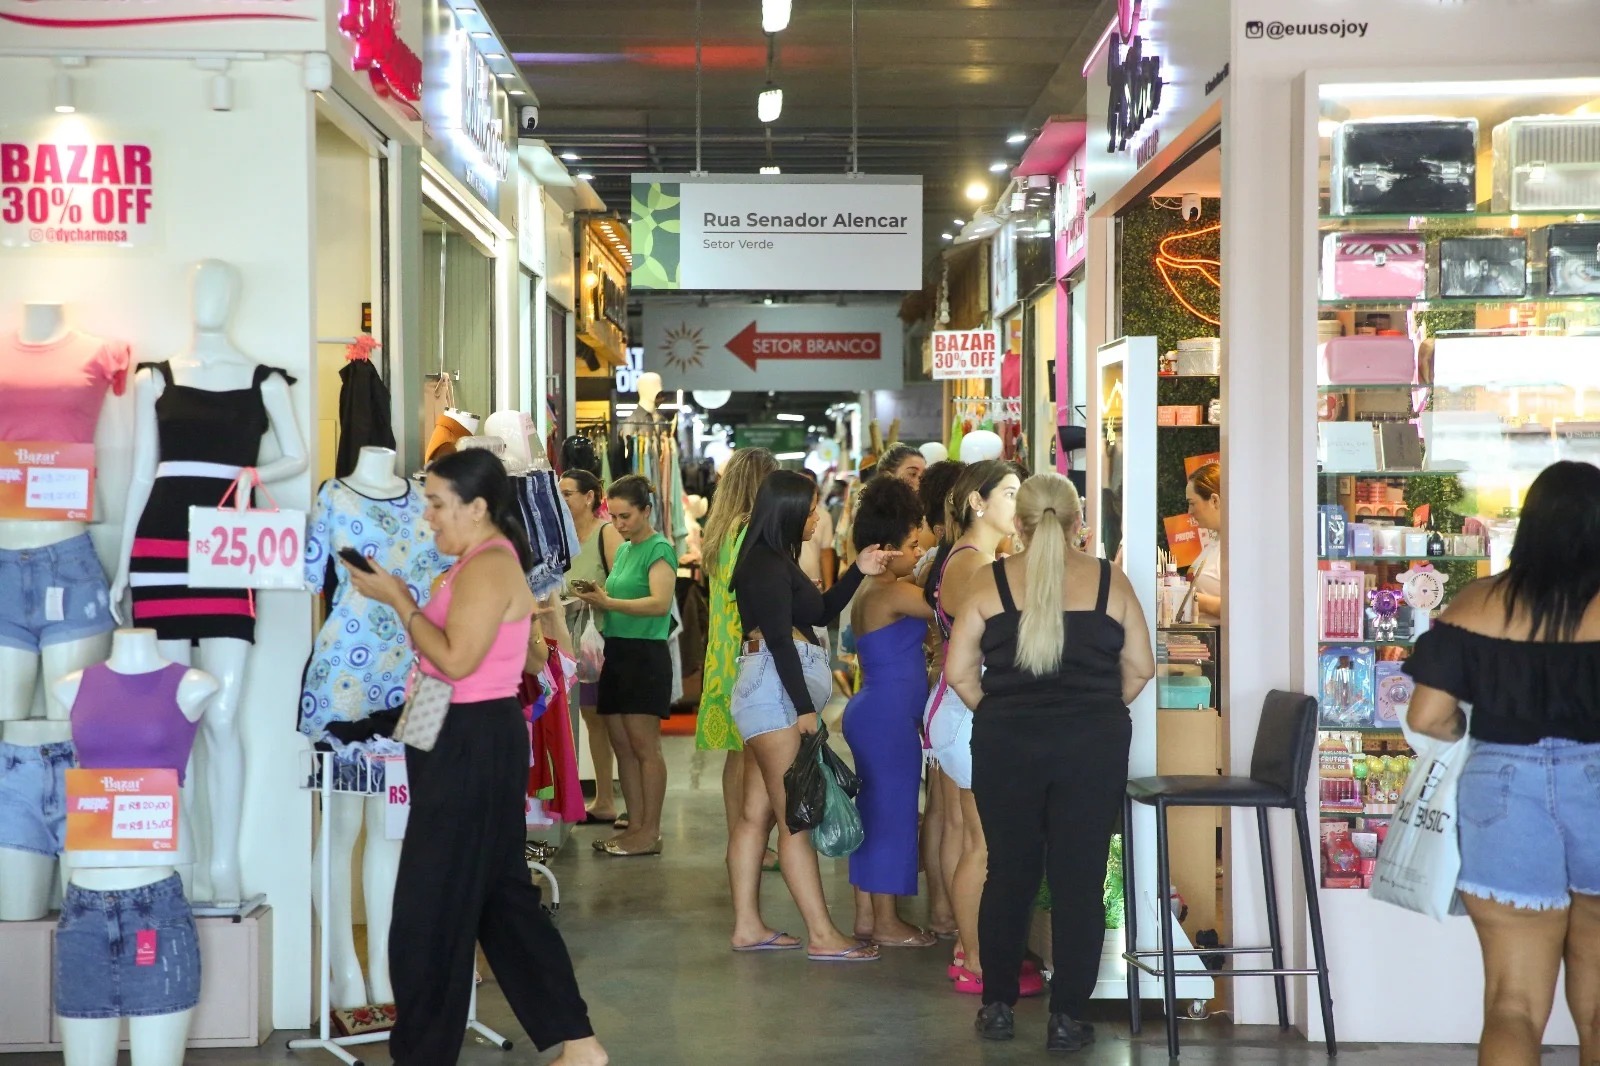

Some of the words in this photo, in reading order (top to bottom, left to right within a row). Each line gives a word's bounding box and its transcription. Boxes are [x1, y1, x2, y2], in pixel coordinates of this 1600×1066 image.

[1266, 20, 1369, 40] @euusojoy
[0, 143, 152, 185] BAZAR
[2, 187, 83, 224] 30%
[93, 187, 152, 224] OFF
[703, 212, 741, 227] Rua
[746, 212, 828, 228] Senador
[832, 213, 908, 228] Alencar
[46, 228, 128, 242] @dycharmosa
[703, 239, 735, 249] Setor
[739, 239, 774, 249] Verde
[752, 339, 802, 354] SETOR
[806, 339, 876, 354] BRANCO
[935, 333, 995, 351] BAZAR
[935, 352, 967, 369] 30%
[970, 351, 995, 368] OFF
[17, 448, 56, 465] Bazar
[195, 538, 210, 555] R$
[211, 525, 299, 575] 25,00
[103, 776, 140, 790] Bazar
[390, 784, 408, 805] R$
